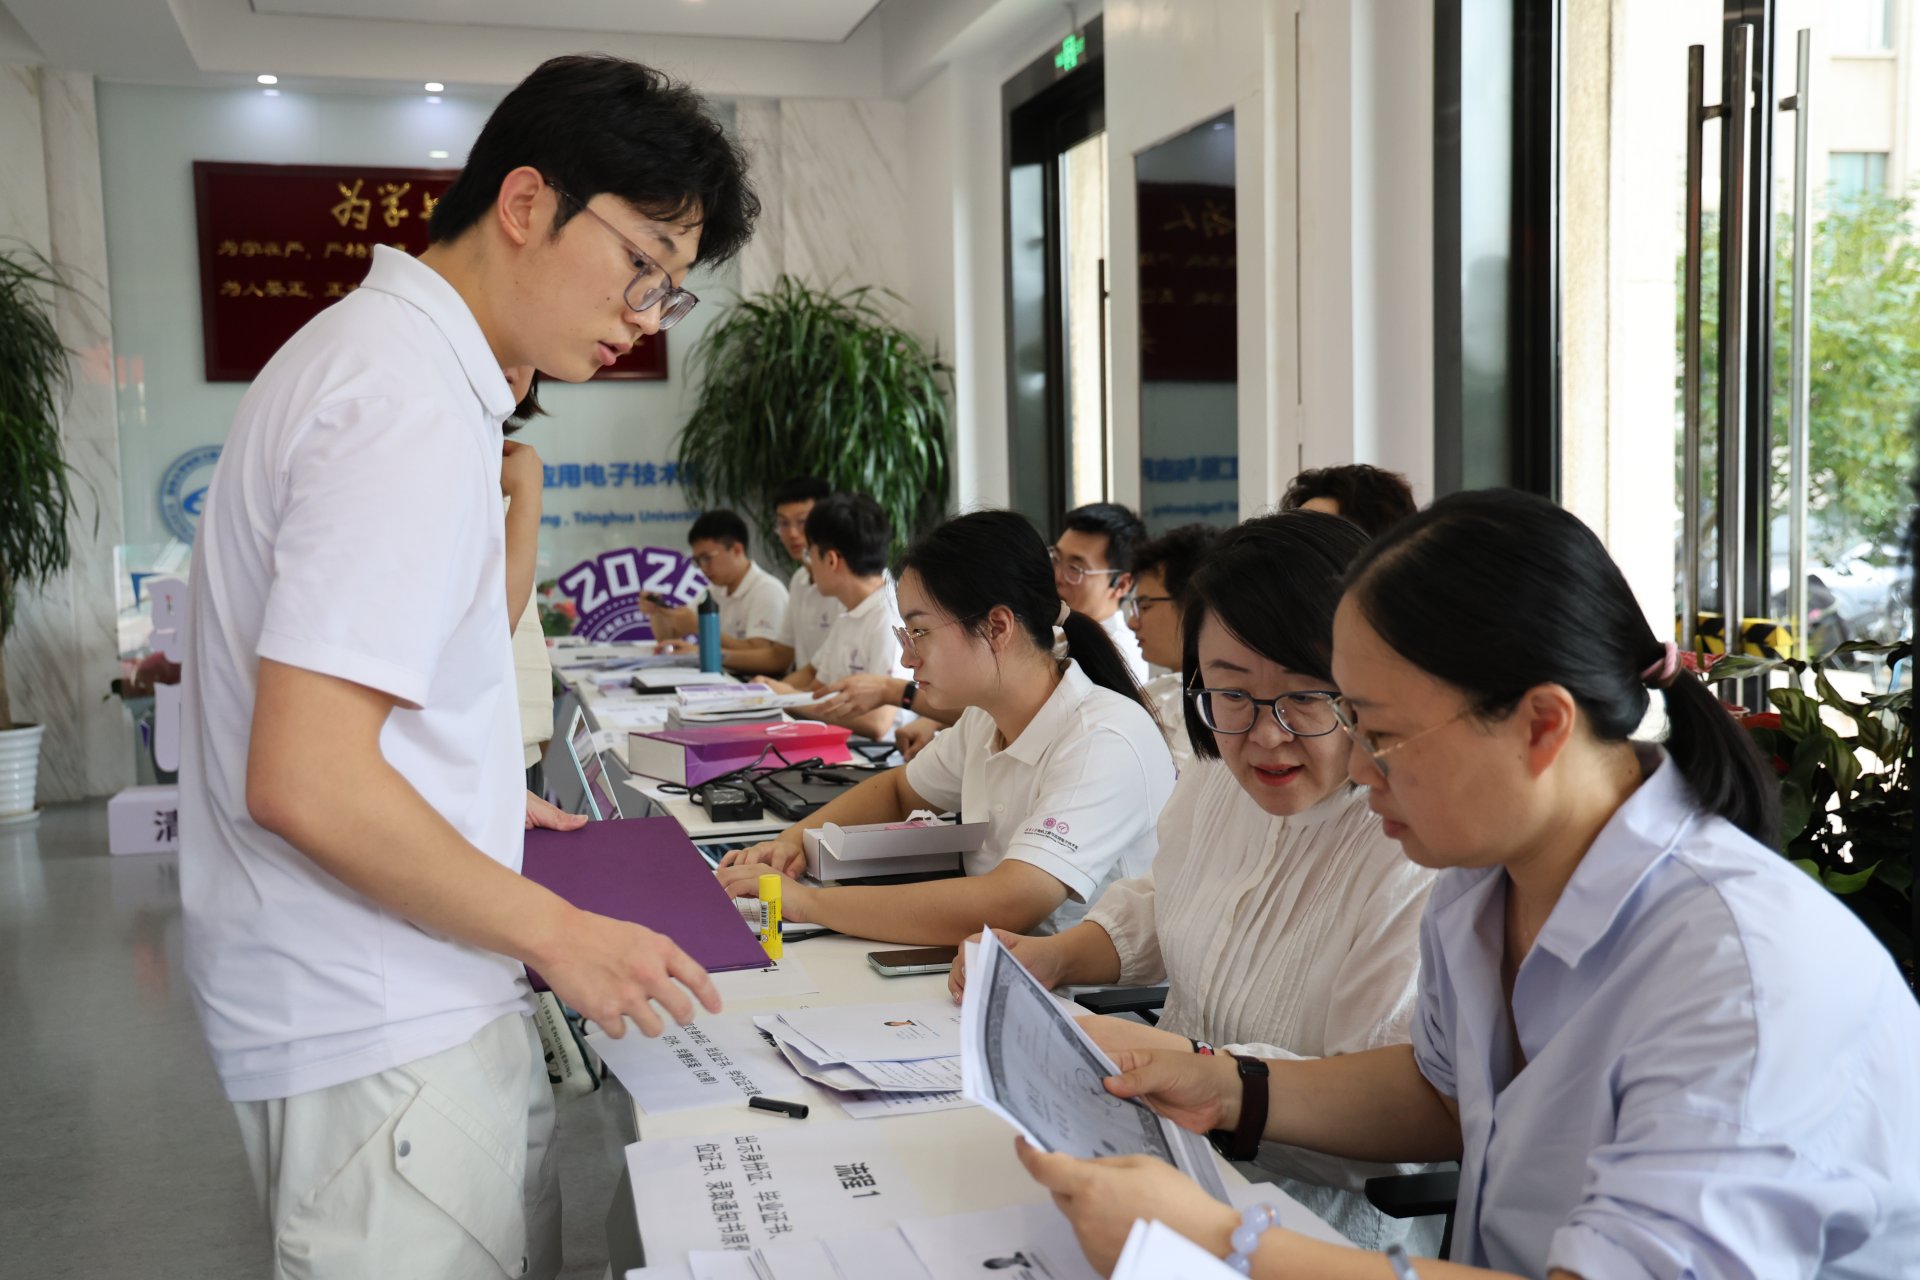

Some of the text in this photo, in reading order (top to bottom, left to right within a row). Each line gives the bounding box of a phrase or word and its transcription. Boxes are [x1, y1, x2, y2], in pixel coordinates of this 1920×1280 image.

[543, 462, 690, 487] 应用电子技术
[640, 510, 702, 522] Universit
[564, 552, 708, 615] 2026
[735, 1135, 793, 1240] 出示身份证、毕业证书、
